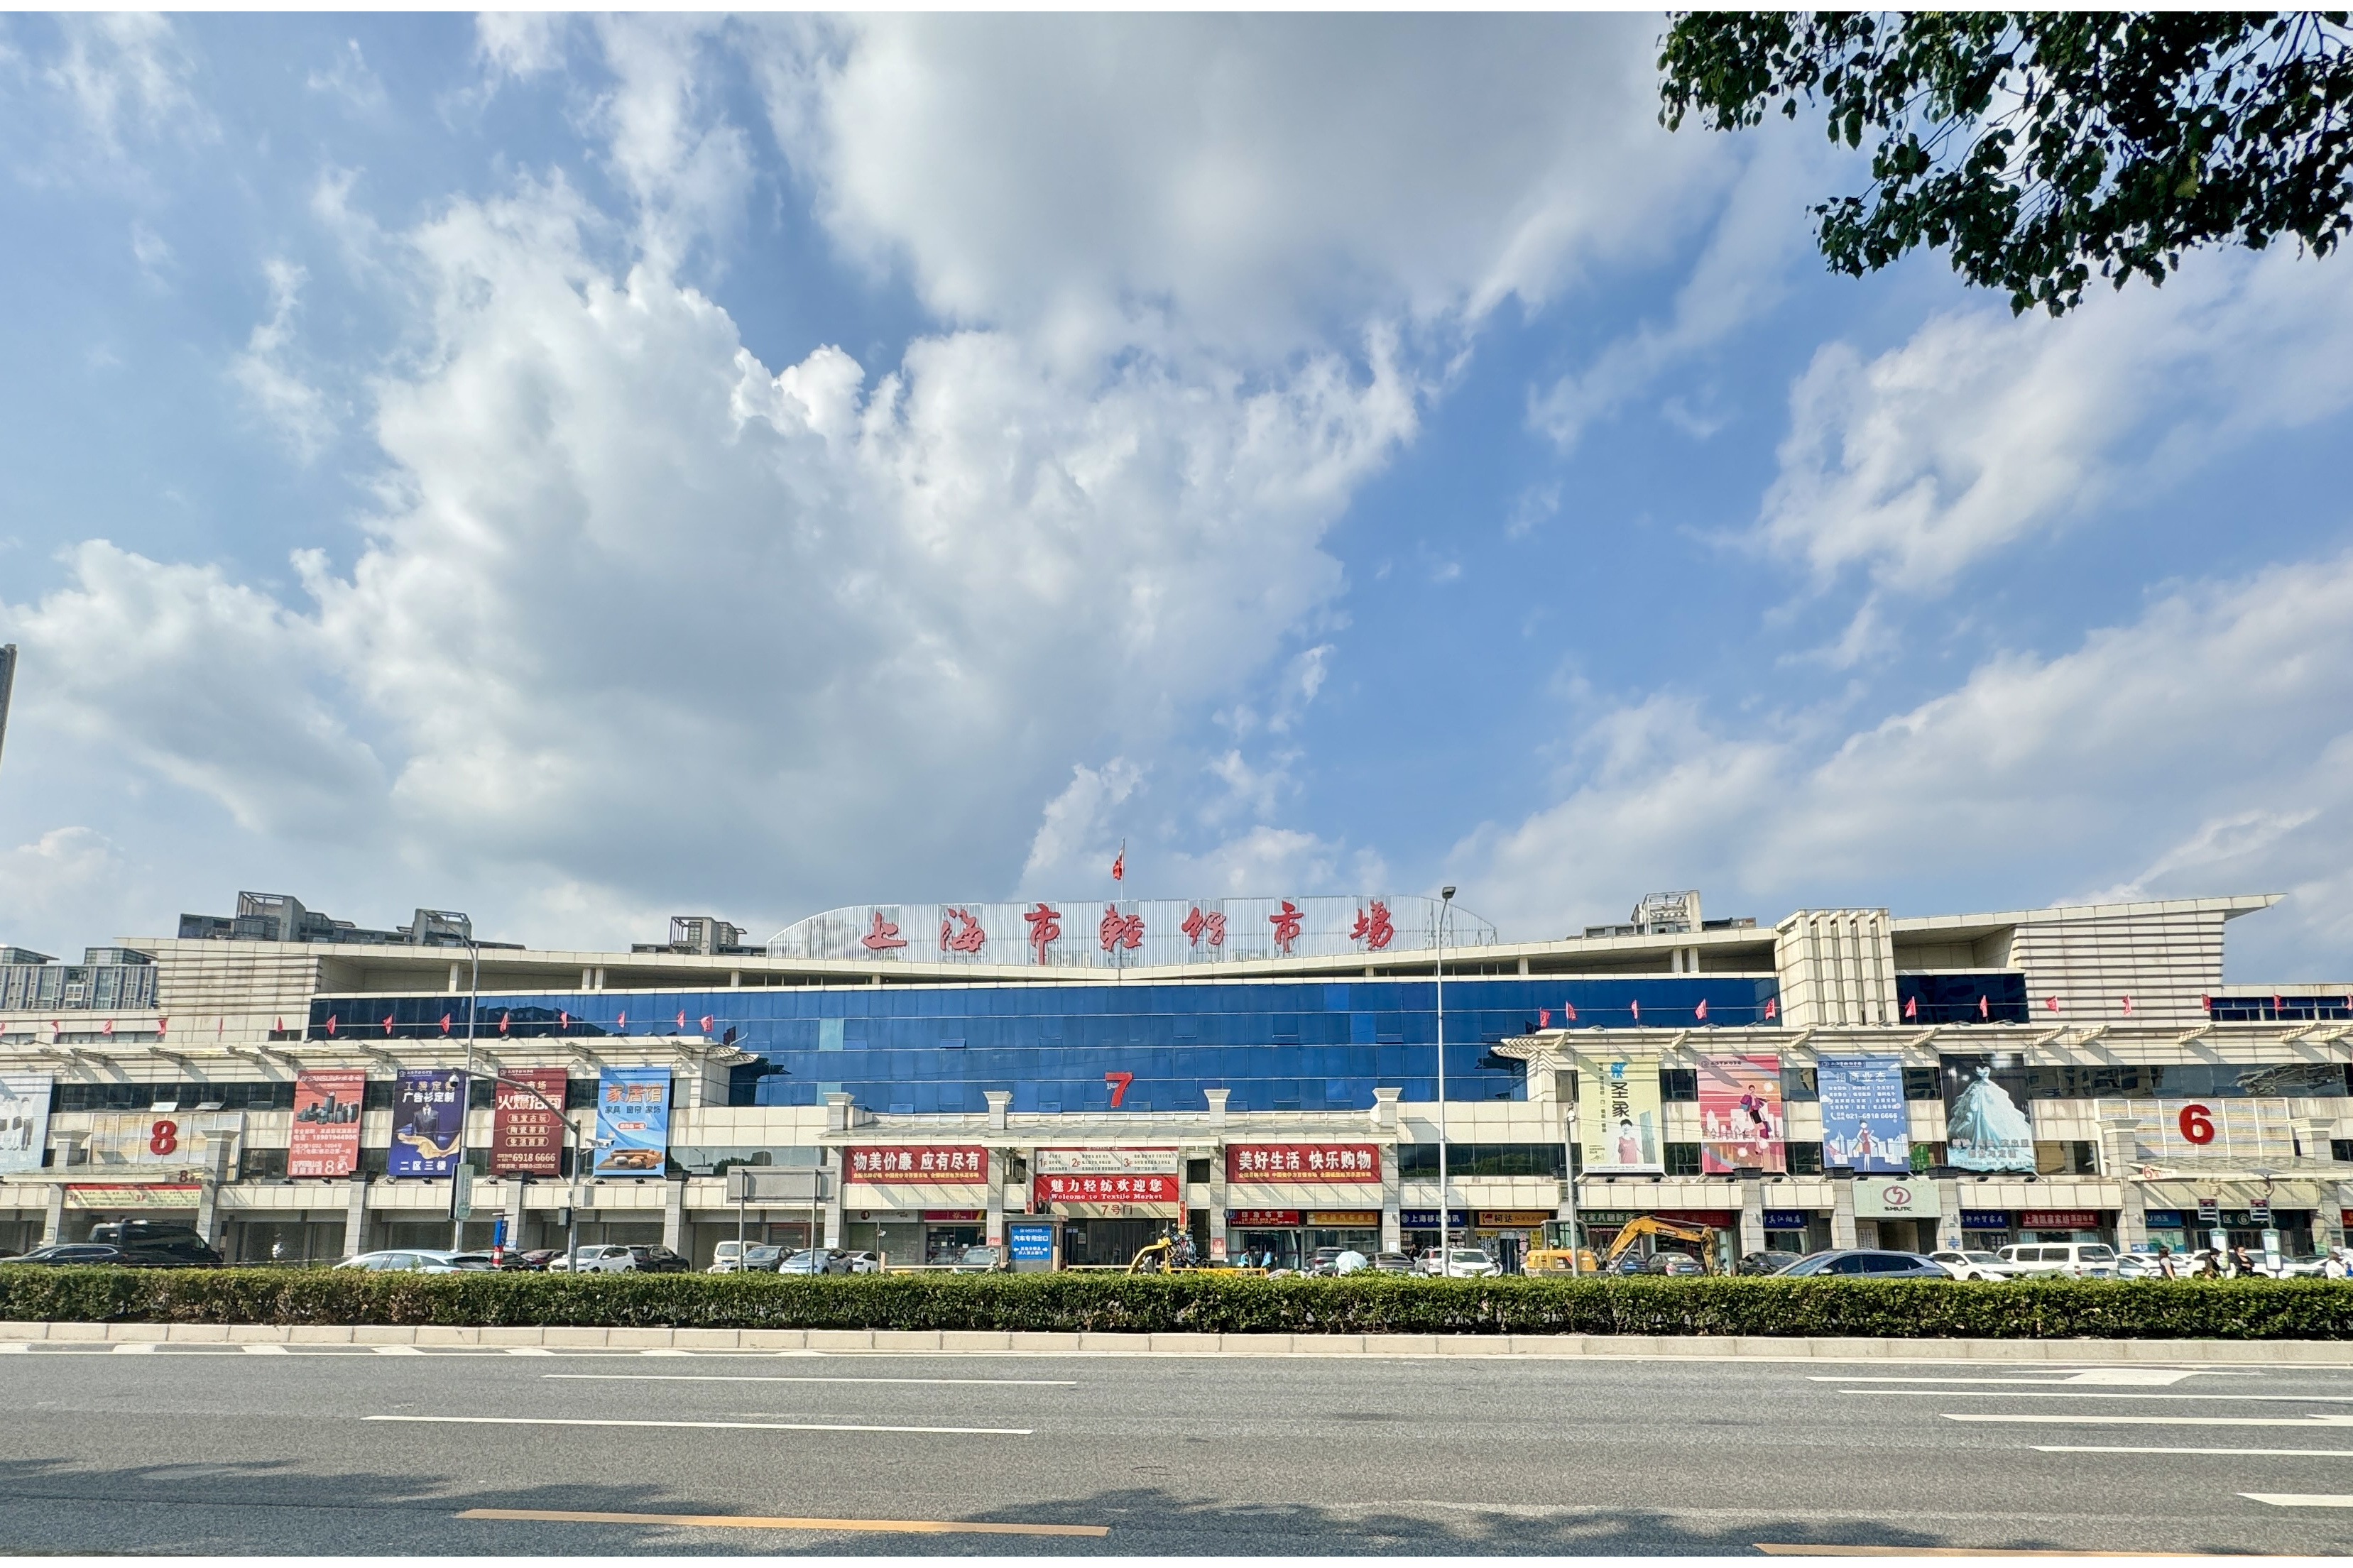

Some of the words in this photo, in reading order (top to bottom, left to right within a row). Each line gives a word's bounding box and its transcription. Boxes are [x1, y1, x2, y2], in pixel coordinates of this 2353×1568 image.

[1835, 1071, 1886, 1082] 招商业态
[402, 1091, 455, 1104] 广告衫定制
[606, 1083, 664, 1103] 家居馆
[1105, 1071, 1133, 1109] 7
[497, 1094, 562, 1110] 火爆招商
[1611, 1082, 1630, 1118] 圣象
[605, 1106, 621, 1114] 家具
[2178, 1104, 2216, 1145] 6
[149, 1119, 178, 1156] 8
[513, 1153, 534, 1162] 6918
[535, 1153, 556, 1162] 6666
[853, 1151, 912, 1170] 物美价廉
[920, 1151, 981, 1170] 应有尽有
[1238, 1151, 1300, 1170] 美好生活
[1309, 1150, 1372, 1170] 快乐购物
[400, 1161, 447, 1171] 二区三楼
[1051, 1178, 1163, 1193] 魅力轻纺欢迎您
[1101, 1205, 1133, 1216] 7号门
[1494, 1214, 1513, 1223] 柯达
